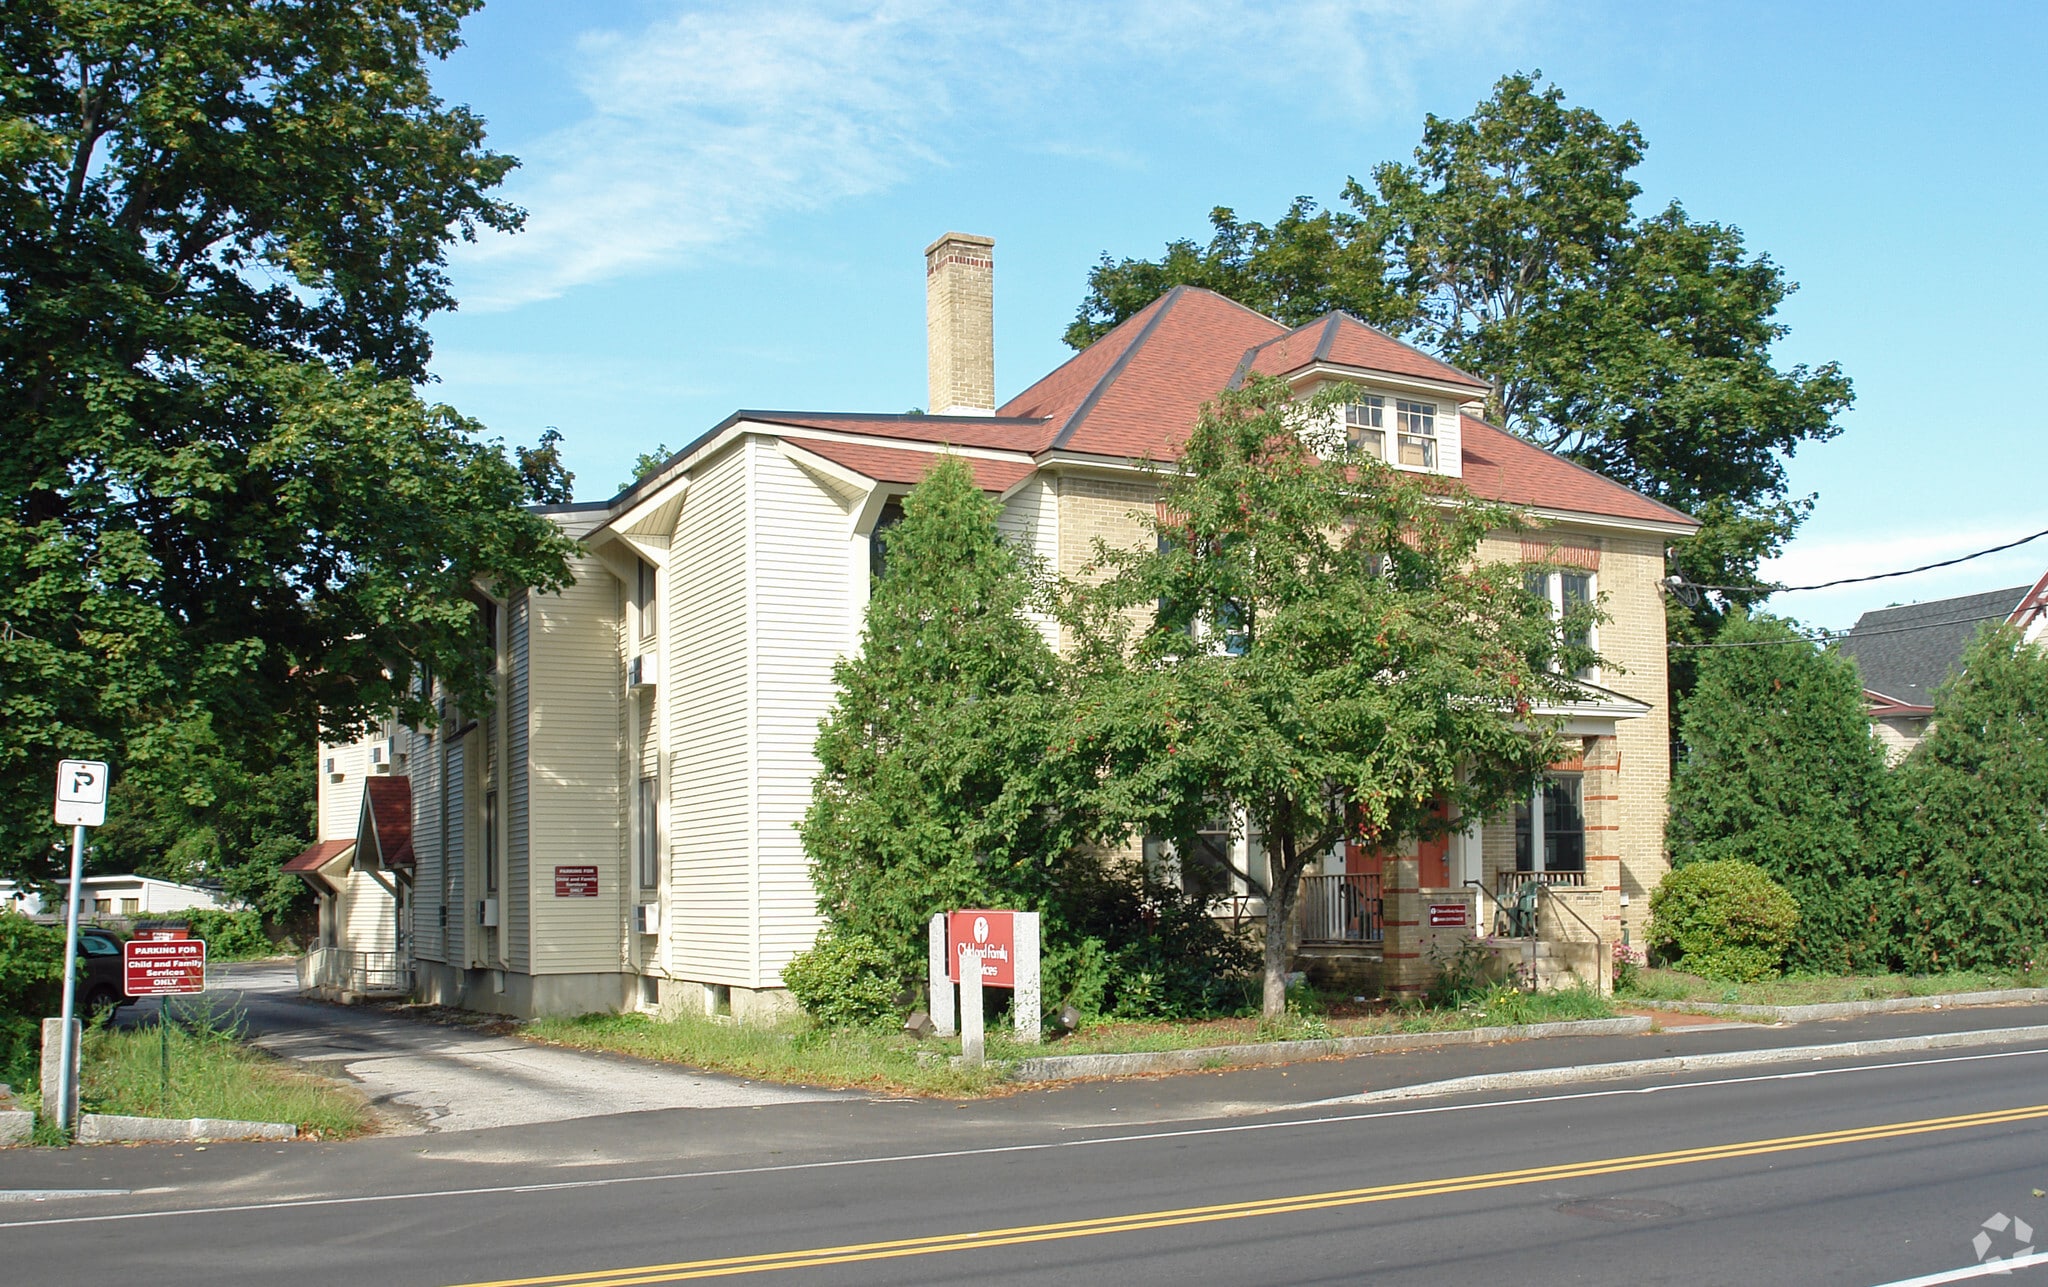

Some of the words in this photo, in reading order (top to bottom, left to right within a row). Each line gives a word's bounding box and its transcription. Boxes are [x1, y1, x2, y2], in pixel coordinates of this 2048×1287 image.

[73, 771, 95, 793] P
[154, 960, 172, 968] and
[173, 959, 202, 968] Family
[146, 969, 185, 977] Services
[153, 978, 178, 986] ONLY
